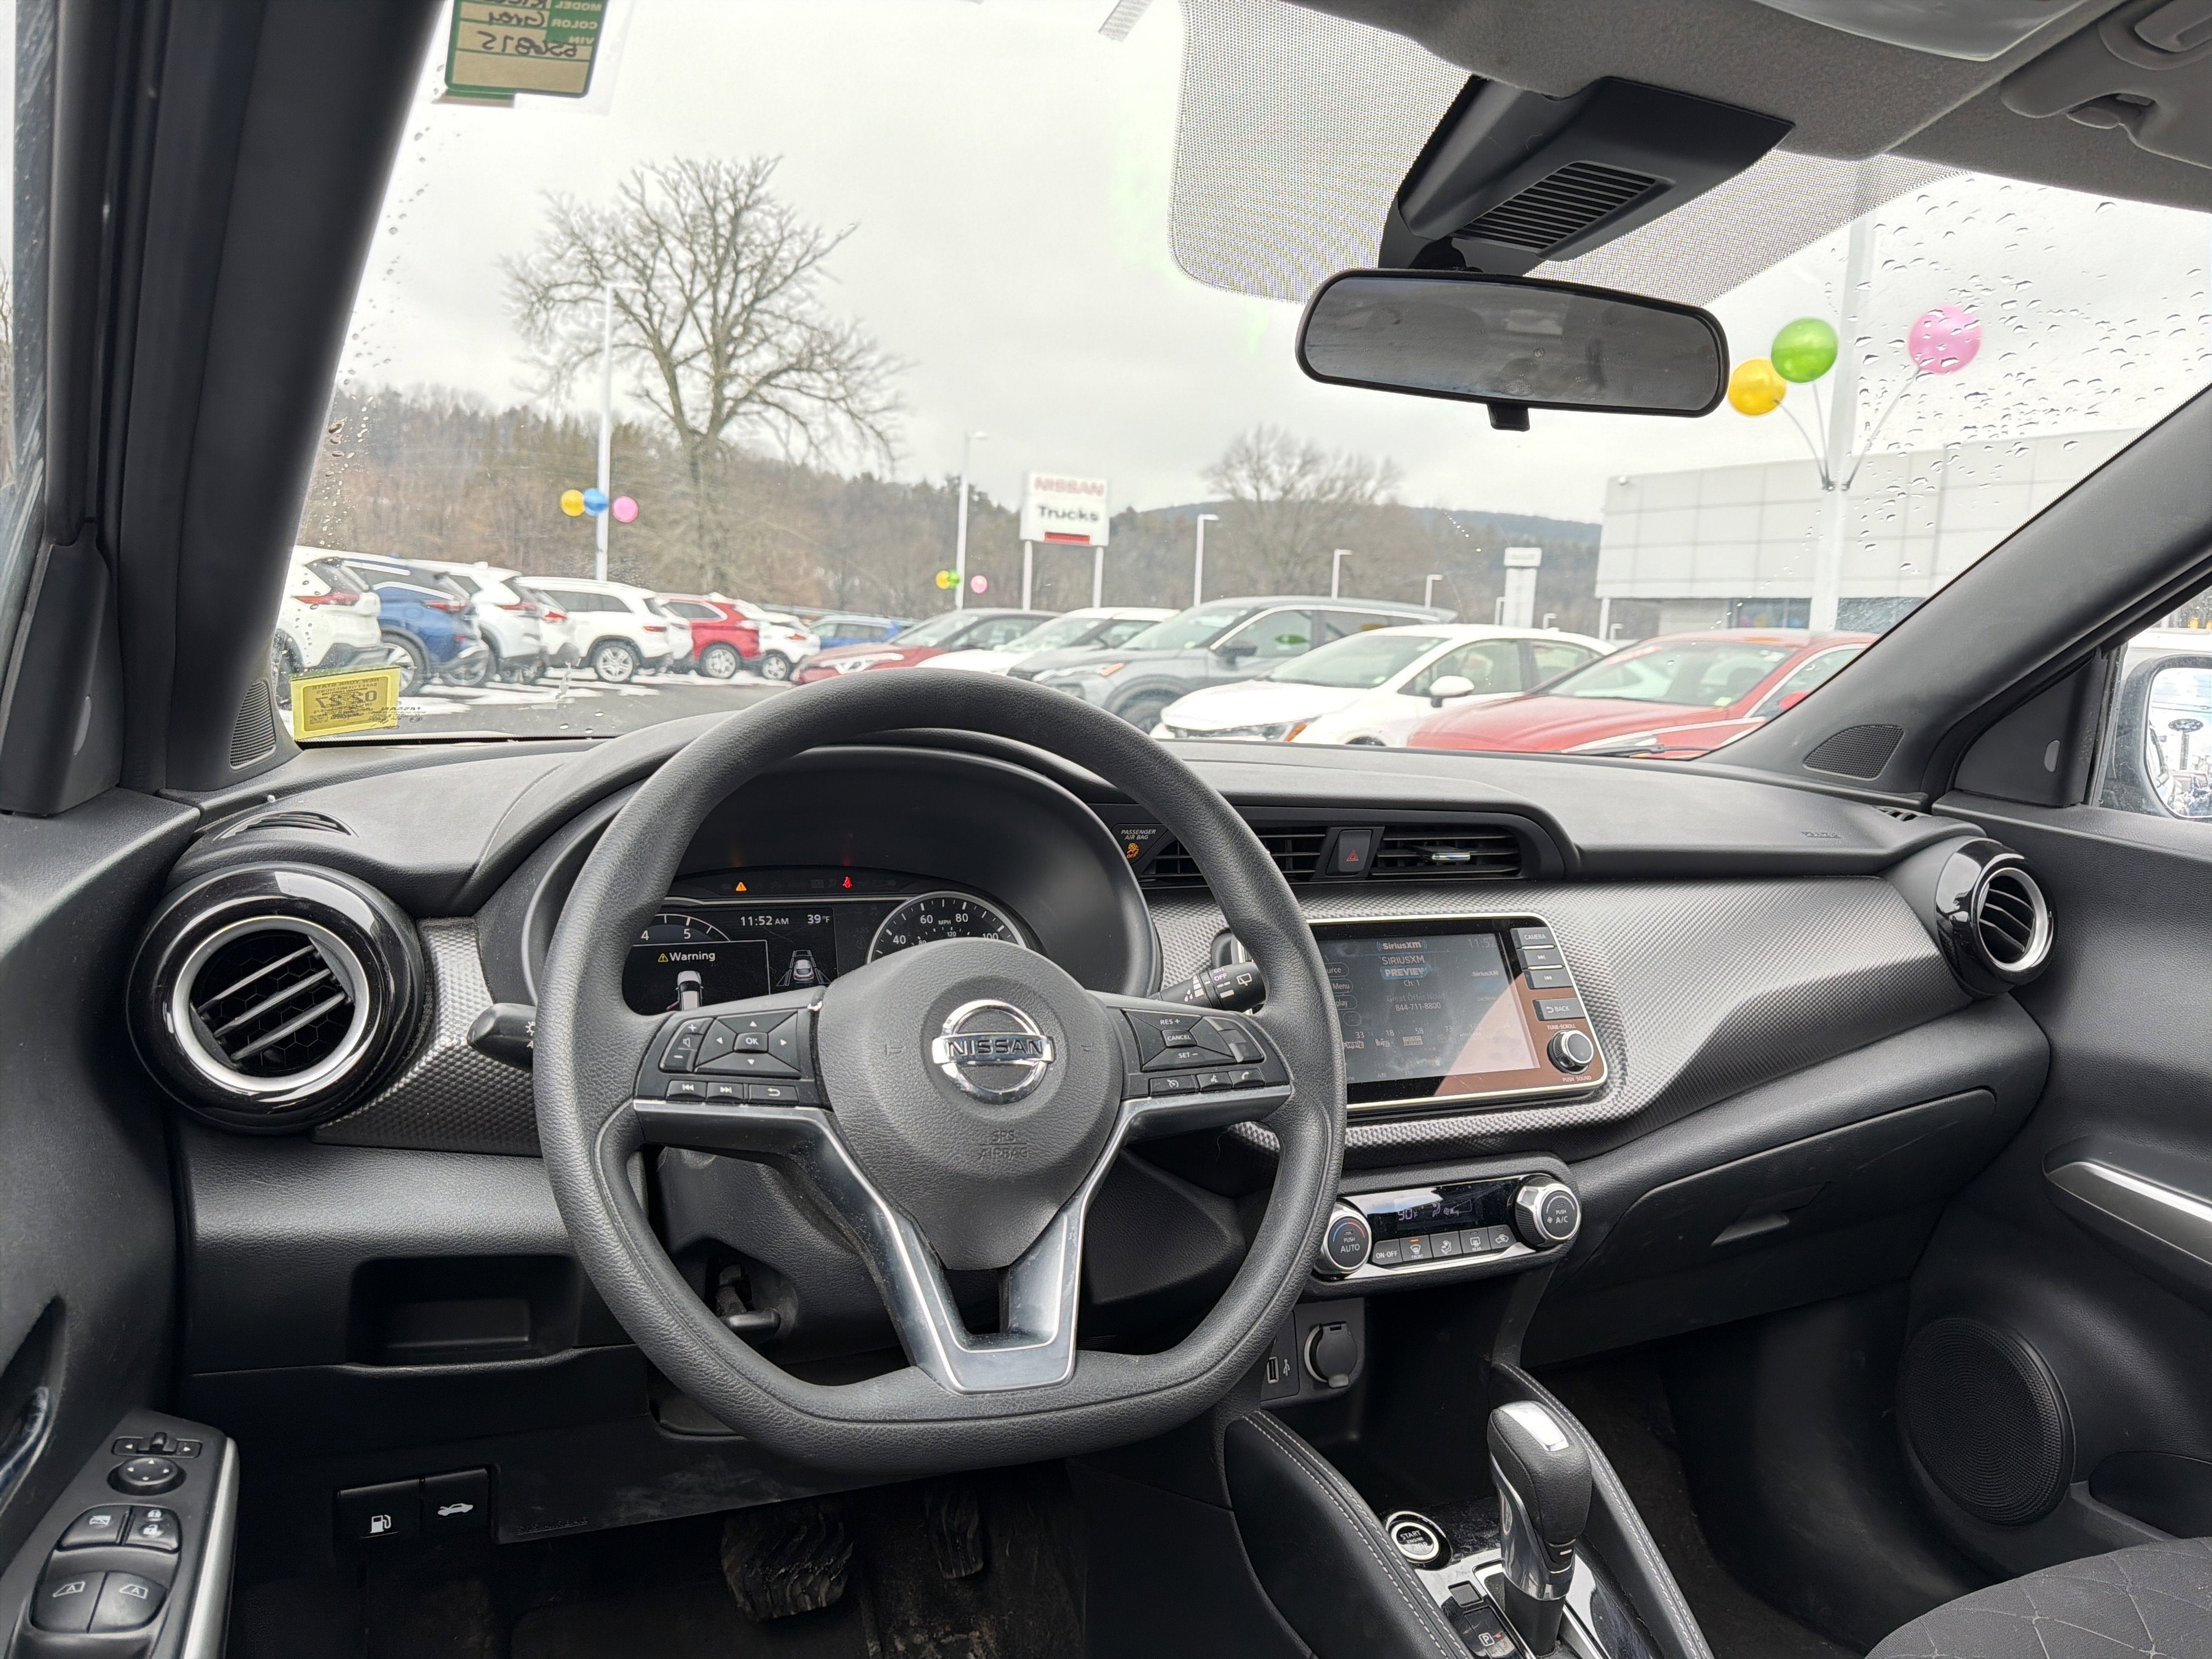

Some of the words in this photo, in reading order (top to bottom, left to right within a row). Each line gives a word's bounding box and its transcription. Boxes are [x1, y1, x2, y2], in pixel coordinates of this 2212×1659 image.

[1035, 476, 1104, 496] NISSAN
[1039, 506, 1099, 521] Trucks
[740, 916, 772, 926] 11:52
[920, 915, 933, 924] 60
[955, 913, 968, 922] 80
[641, 930, 650, 940] 4
[684, 928, 691, 939] 5
[893, 935, 906, 944] 40
[669, 951, 715, 962] Warning
[1381, 955, 1425, 965] SIRIUSXM
[1214, 973, 1227, 981] OFF
[1385, 967, 1427, 977] PREVIEW
[1395, 1002, 1441, 1012] 844-711-8800
[746, 1037, 759, 1045] OK
[947, 1040, 1043, 1056] NISSAN
[992, 1130, 1015, 1142] SRS
[1555, 1215, 1568, 1224] A/C
[1340, 1244, 1360, 1252] AUTO
[1400, 1530, 1421, 1540] START
[1482, 1634, 1490, 1644] P
